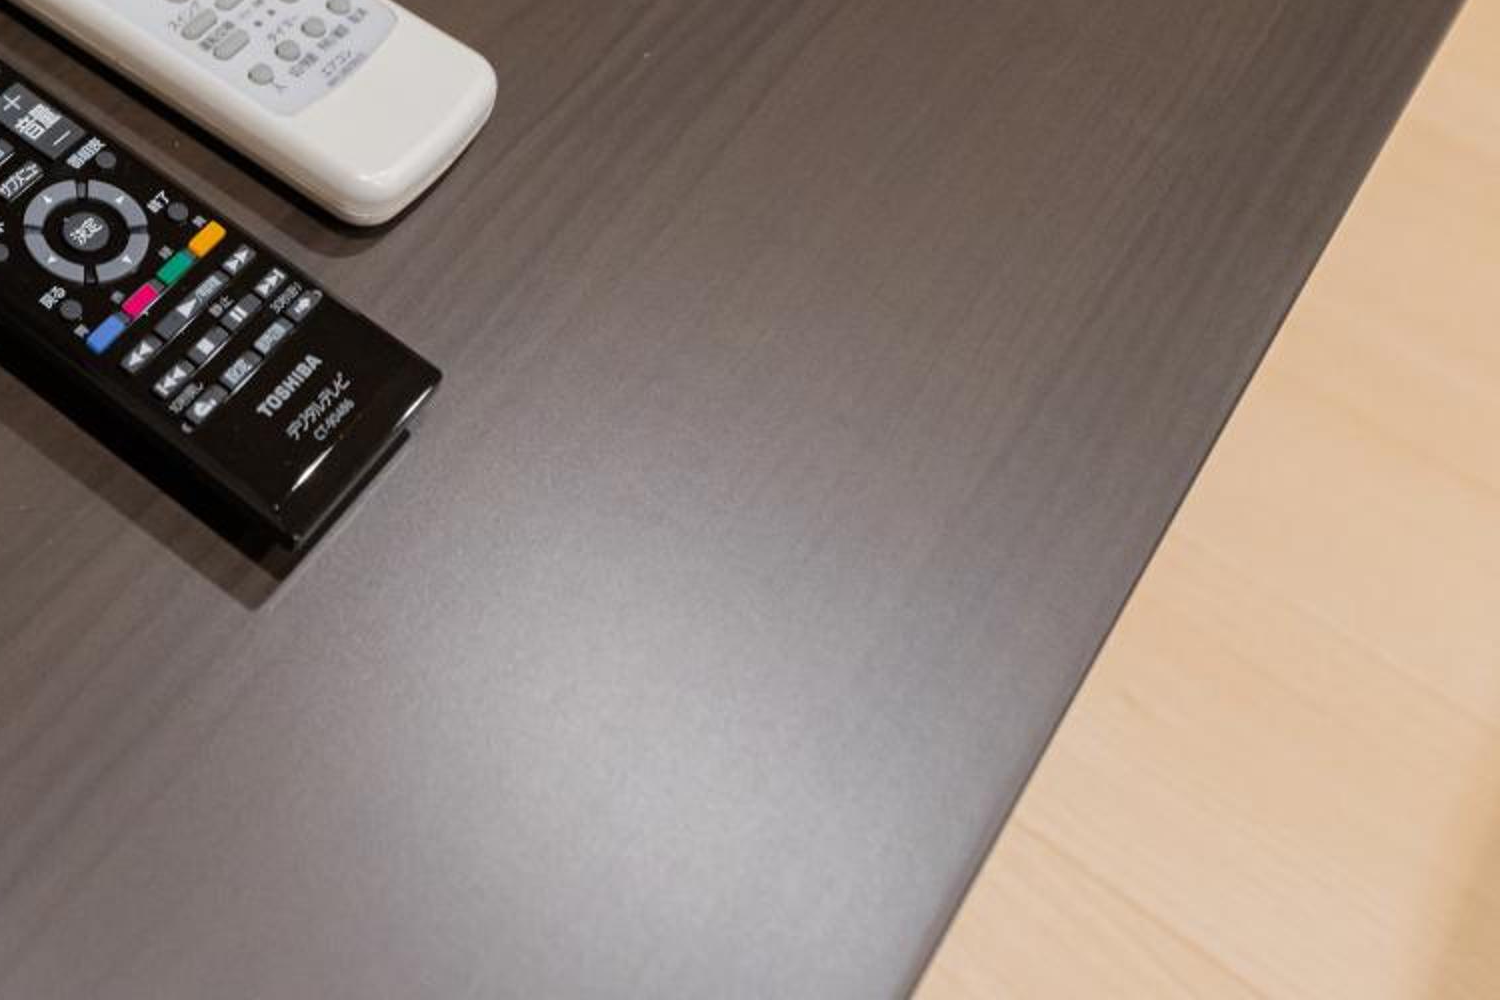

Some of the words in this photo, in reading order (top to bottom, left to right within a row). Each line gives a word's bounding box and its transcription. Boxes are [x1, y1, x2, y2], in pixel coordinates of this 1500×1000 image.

[14, 103, 62, 141] 音量
[69, 217, 102, 245] 決定
[256, 354, 323, 417] TOSHIBA
[286, 371, 351, 440] デジタルテレビ
